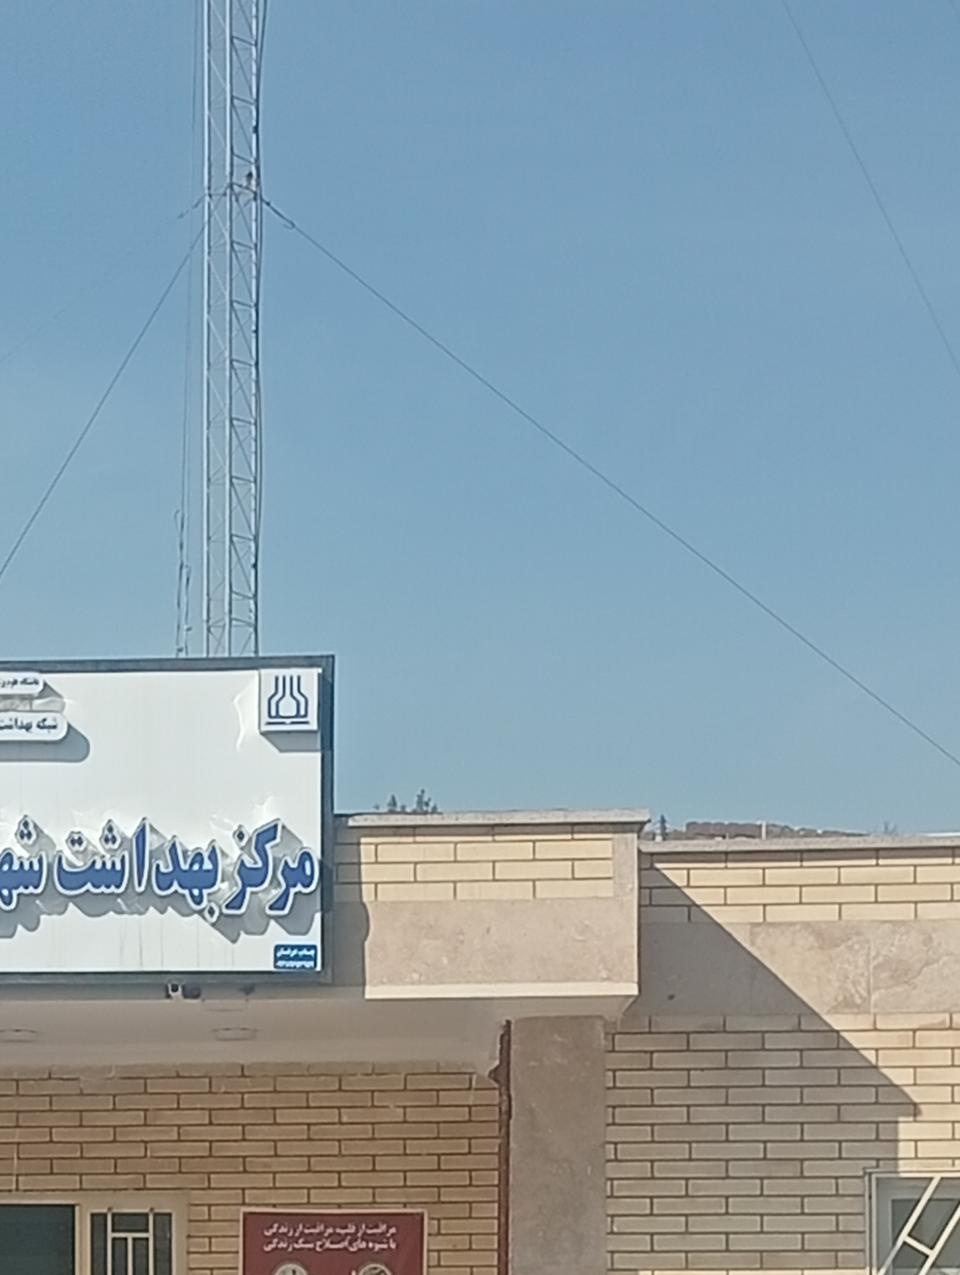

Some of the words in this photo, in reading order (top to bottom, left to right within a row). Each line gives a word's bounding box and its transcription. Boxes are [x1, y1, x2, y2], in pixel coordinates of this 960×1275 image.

[36, 717, 58, 733] شبکه
[54, 817, 222, 925] بهداشت
[222, 818, 320, 915] مرکز
[263, 1222, 294, 1237] زندگی
[303, 1221, 334, 1237] مراقبت
[365, 1222, 397, 1237] مراقبت
[263, 1237, 293, 1252] زندگی
[293, 1238, 315, 1249] سبک
[315, 1235, 352, 1252] اصلاح
